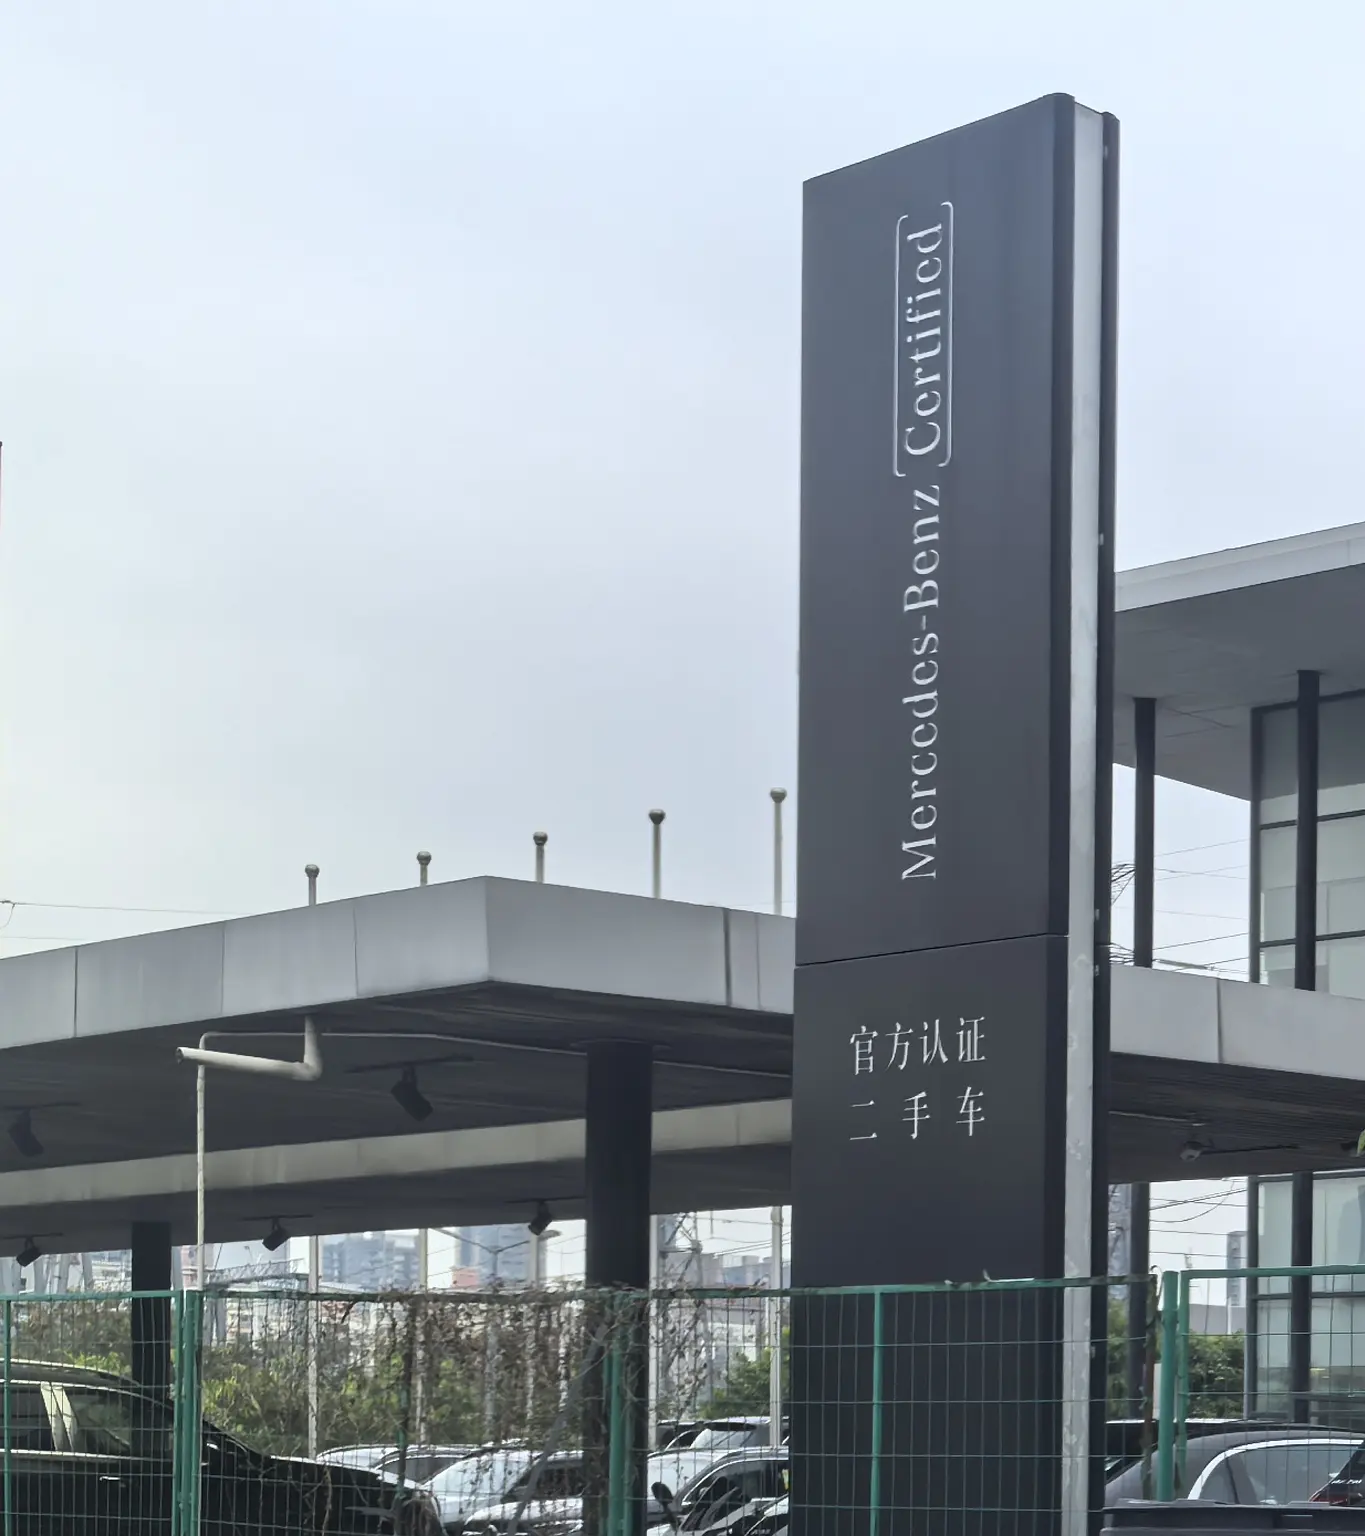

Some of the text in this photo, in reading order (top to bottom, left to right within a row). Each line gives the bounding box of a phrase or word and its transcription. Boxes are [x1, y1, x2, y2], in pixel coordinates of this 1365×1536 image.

[901, 223, 943, 880] Mercedes-Benz Certified
[849, 1016, 986, 1076] 官方认证
[849, 1086, 986, 1140] 二手车
